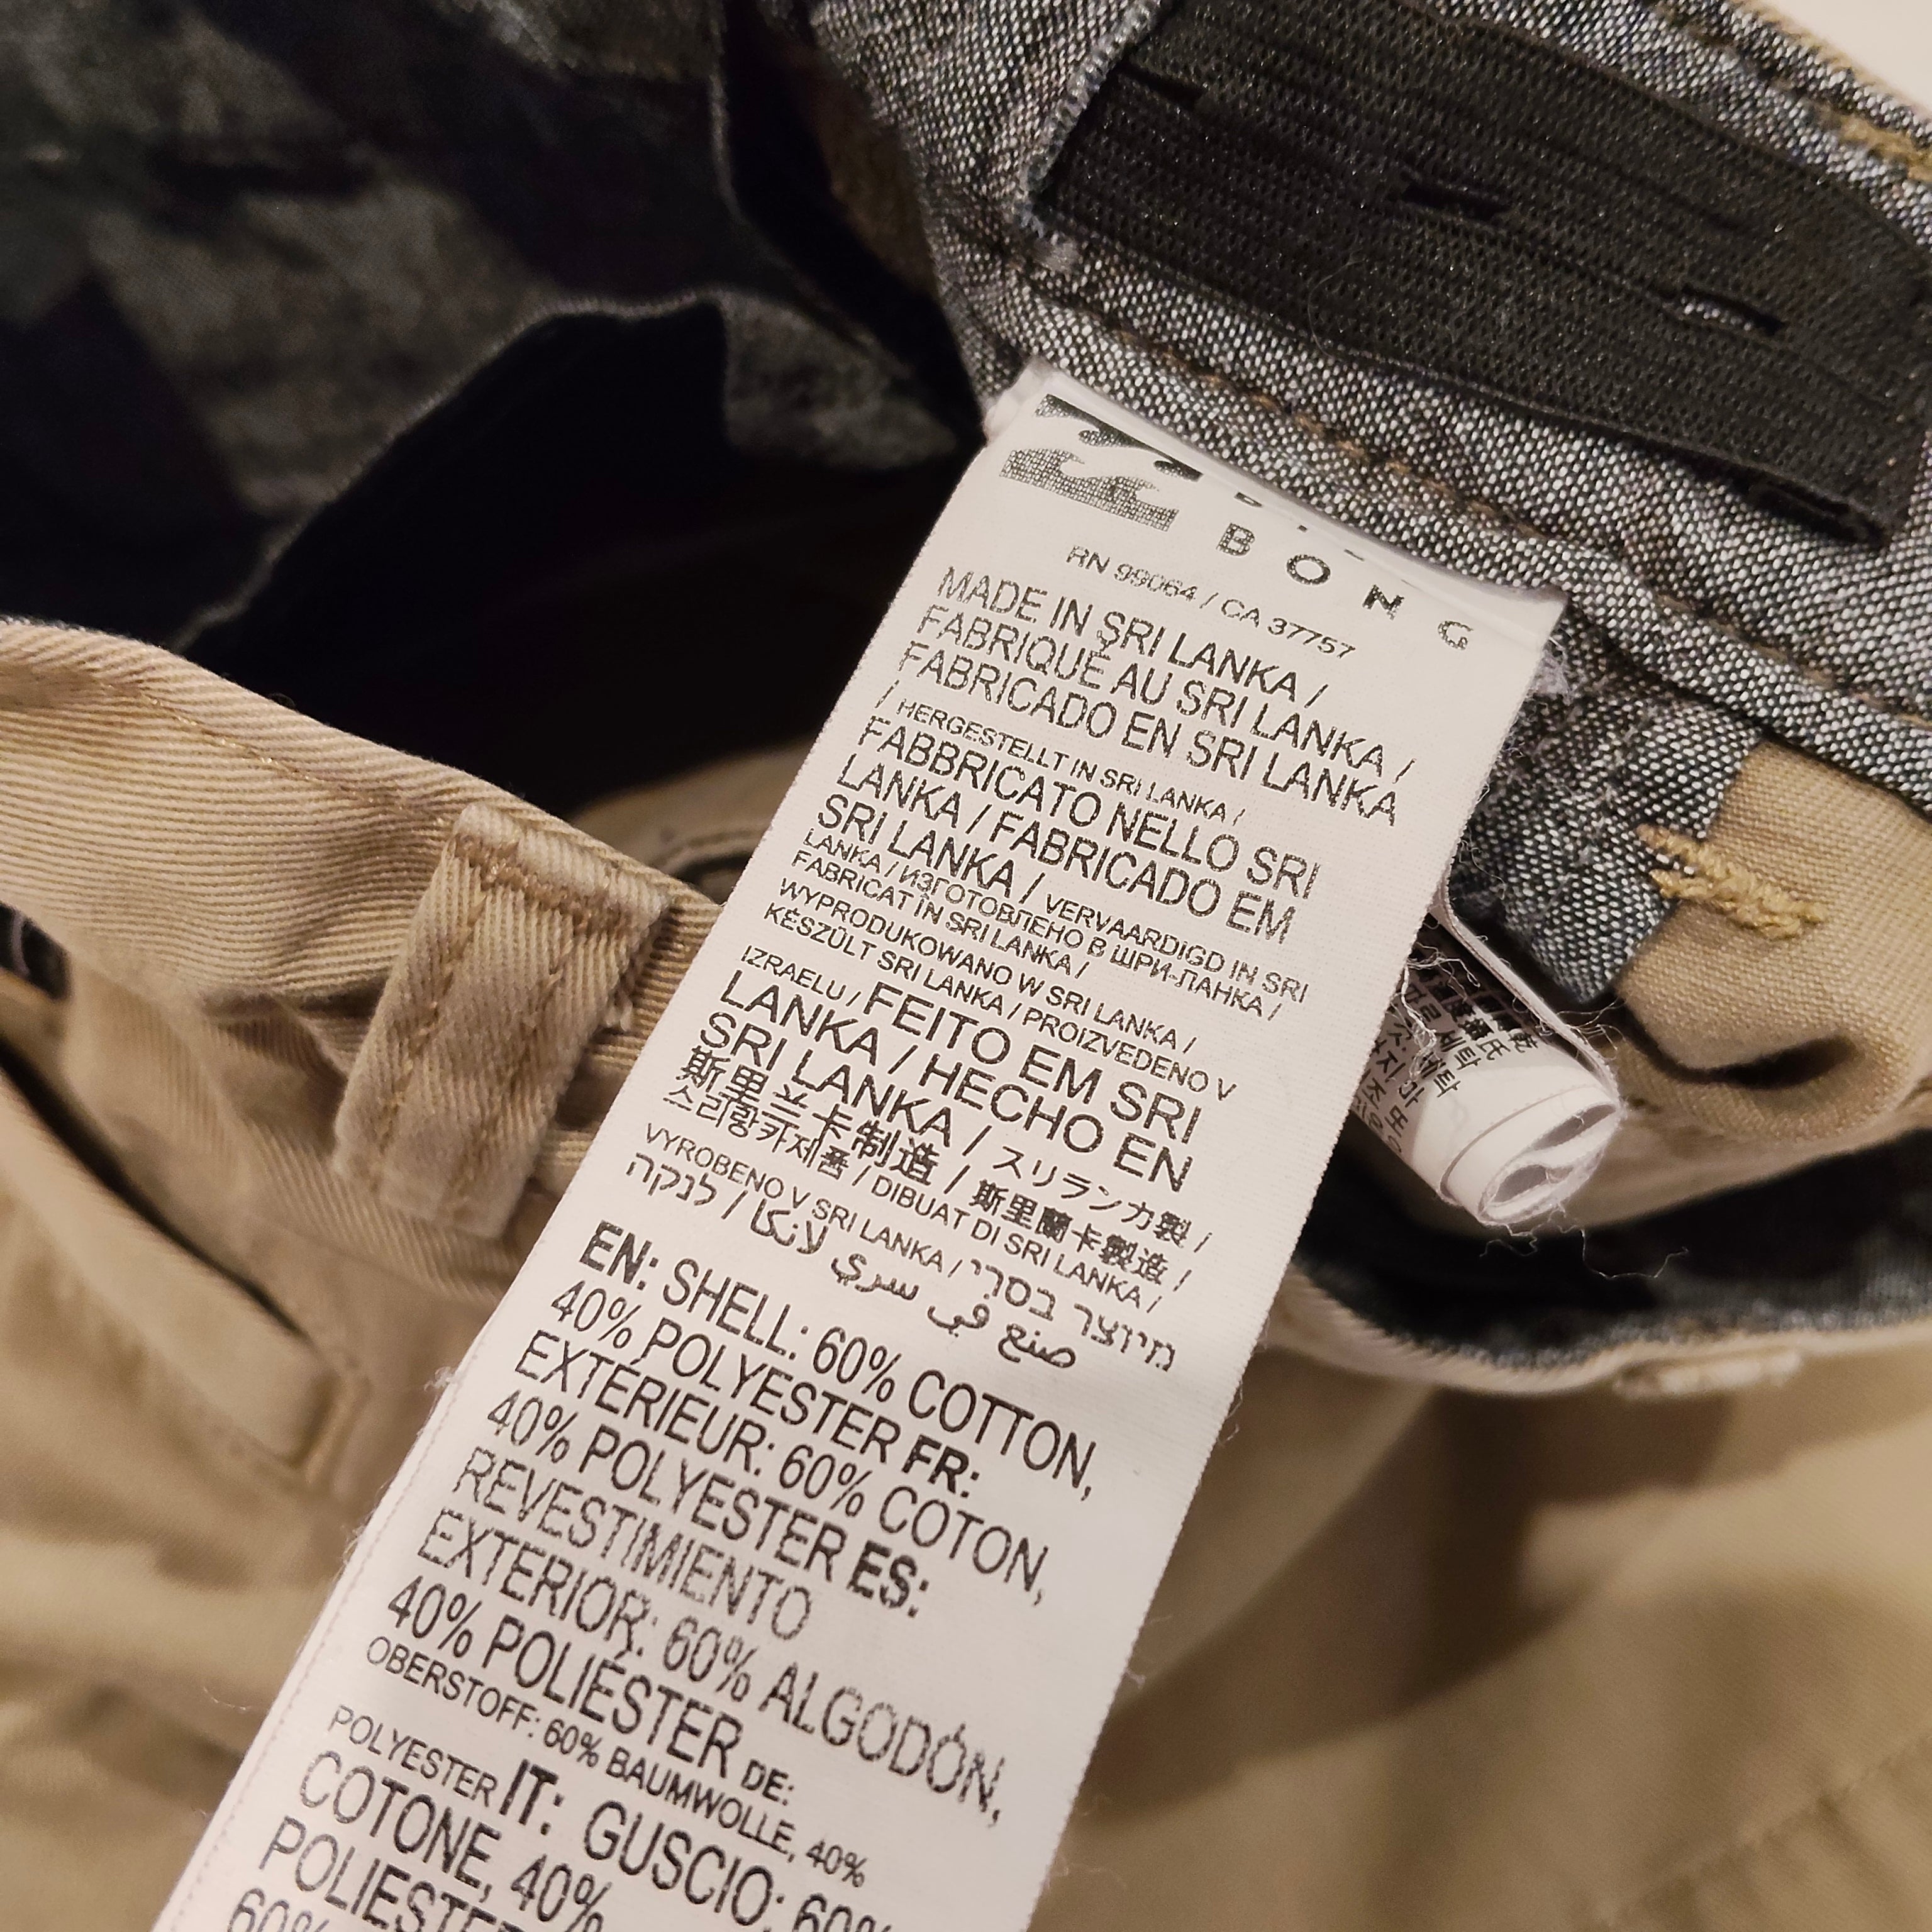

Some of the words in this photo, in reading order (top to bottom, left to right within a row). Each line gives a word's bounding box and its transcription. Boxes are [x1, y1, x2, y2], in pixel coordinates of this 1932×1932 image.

[938, 566, 1046, 623] MADE
[1049, 599, 1092, 636] IN
[1096, 614, 1164, 658] SRI
[1167, 636, 1297, 703] LANKA
[1304, 684, 1329, 708] /
[1066, 547, 1110, 574] RN
[1199, 594, 1216, 609] /
[1221, 600, 1260, 628] CA
[1267, 618, 1356, 658] 37757
[1218, 523, 1472, 650] BONG
[875, 680, 899, 708] /
[896, 699, 1070, 770] HERGESTELLT
[1070, 758, 1098, 782] IN
[1099, 768, 1142, 797] SRI
[1145, 782, 1226, 823] LANKA
[1232, 809, 1245, 826] /
[898, 640, 1117, 737] FABRICADO
[1121, 710, 1182, 758] EN
[1186, 730, 1258, 780] SRI
[1261, 753, 1396, 827] LANKA
[1109, 664, 1172, 706] AU
[1176, 683, 1246, 729] SRI
[1250, 707, 1383, 778] LANKA
[1395, 759, 1415, 783] /
[836, 753, 961, 829] LANKA
[965, 804, 992, 834] /
[989, 810, 1221, 918] FABRICADO
[1225, 890, 1296, 945] EM
[857, 715, 1102, 826] FABBRICATO
[1106, 801, 1240, 872] NELLO
[1246, 846, 1320, 899] SRI
[779, 877, 1013, 985] WYPRODUKOWANO
[1018, 972, 1045, 997] W
[1045, 985, 1092, 1016] SRI
[1093, 1002, 1177, 1050] LANKA
[1182, 1037, 1197, 1054] /
[791, 850, 914, 911] FABRICAT
[945, 911, 991, 943] SRI
[989, 928, 1071, 976] LANKA
[1074, 961, 1090, 979] /
[803, 828, 880, 874] LANKA
[884, 861, 899, 877] /
[898, 865, 1084, 949] ИЗГОТОВЛЕНО
[1087, 936, 1108, 957] В
[1109, 944, 1262, 1017] ШРИ-ЛАНКА
[1267, 1004, 1282, 1021] /
[818, 794, 888, 845] SRI
[887, 819, 1014, 899] LANKA
[1018, 872, 1046, 904] /
[1046, 893, 1226, 973] VERVAARDIGD
[1229, 960, 1258, 985] IN
[1262, 972, 1309, 1004] SRI
[719, 969, 879, 1067] LANKA
[887, 1044, 918, 1075] /
[918, 1053, 1104, 1153] HECHO
[1113, 1132, 1193, 1192] EN
[741, 945, 847, 1001] IZRAELU
[845, 991, 862, 1007] /
[863, 981, 1011, 1065] FEITO
[1018, 1044, 1103, 1105] EM
[1109, 1081, 1202, 1145] SRI
[877, 950, 922, 981] SRI
[923, 968, 1003, 1016] LANKA
[1007, 1002, 1023, 1019] /
[1022, 1007, 1209, 1092] PROIZVEDENO
[1218, 1078, 1237, 1101] V
[626, 1152, 717, 1206] לנקה
[647, 1123, 784, 1199] VYROBENO
[675, 1045, 940, 1186] 斯里兰卡制造
[943, 1164, 971, 1195] /
[1173, 1269, 1192, 1292] /
[700, 1011, 788, 1072] SRI
[791, 1048, 952, 1148] LANKA
[962, 1124, 992, 1157] /
[992, 1146, 1192, 1247] スリランカ製
[1193, 1232, 1213, 1253] /
[721, 1190, 748, 1220] /
[792, 1186, 811, 1209] V
[811, 1198, 858, 1233] SRI
[830, 1253, 919, 1301] سري
[852, 1165, 872, 1187] /
[871, 1174, 971, 1230] DIBUAT
[970, 1218, 1001, 1246] DI
[1004, 1233, 1052, 1267] SRI
[1053, 1253, 1141, 1309] LANKA
[1146, 1296, 1162, 1314] /
[859, 1218, 943, 1273] LANKA
[948, 1259, 963, 1278] /
[970, 1258, 1056, 1321] בסרי
[551, 1280, 641, 1350] 40%
[635, 1316, 901, 1465] POLYESTER
[901, 1433, 980, 1499] FR:
[579, 1220, 659, 1291] EN:
[662, 1258, 809, 1360] SHELL:
[813, 1326, 902, 1403] 60%
[908, 1369, 1097, 1501] COTTON,
[927, 1294, 990, 1338] في
[997, 1323, 1077, 1369] صنع
[1074, 1304, 1176, 1372] מיוצר
[487, 1390, 579, 1464] 40%
[578, 1423, 848, 1583] POLYESTER
[846, 1540, 930, 1618] ES:
[514, 1329, 775, 1477] EXTÉRIEUR:
[779, 1443, 873, 1518] 60%
[879, 1485, 1049, 1606] COTON,
[452, 1446, 812, 1641] REVESTIMIENTO
[387, 1575, 482, 1659] 40%
[481, 1614, 743, 1779] POLIÉSTER
[740, 1758, 794, 1806] DE:
[417, 1508, 658, 1657] EXTERIOR:
[662, 1616, 757, 1703] 60%
[758, 1662, 1005, 1824] ALGODÓN,
[330, 1705, 498, 1808] POLYESTER
[498, 1758, 564, 1836] IT:
[367, 1636, 541, 1738] OBERSTOFF:
[543, 1718, 602, 1768] 60%
[605, 1746, 796, 1863] BAUMWOLLE,
[805, 1840, 867, 1888] 40%
[259, 1816, 517, 1932] POLIEST
[299, 1751, 502, 1904] COTONE,
[509, 1854, 612, 1932] 40%
